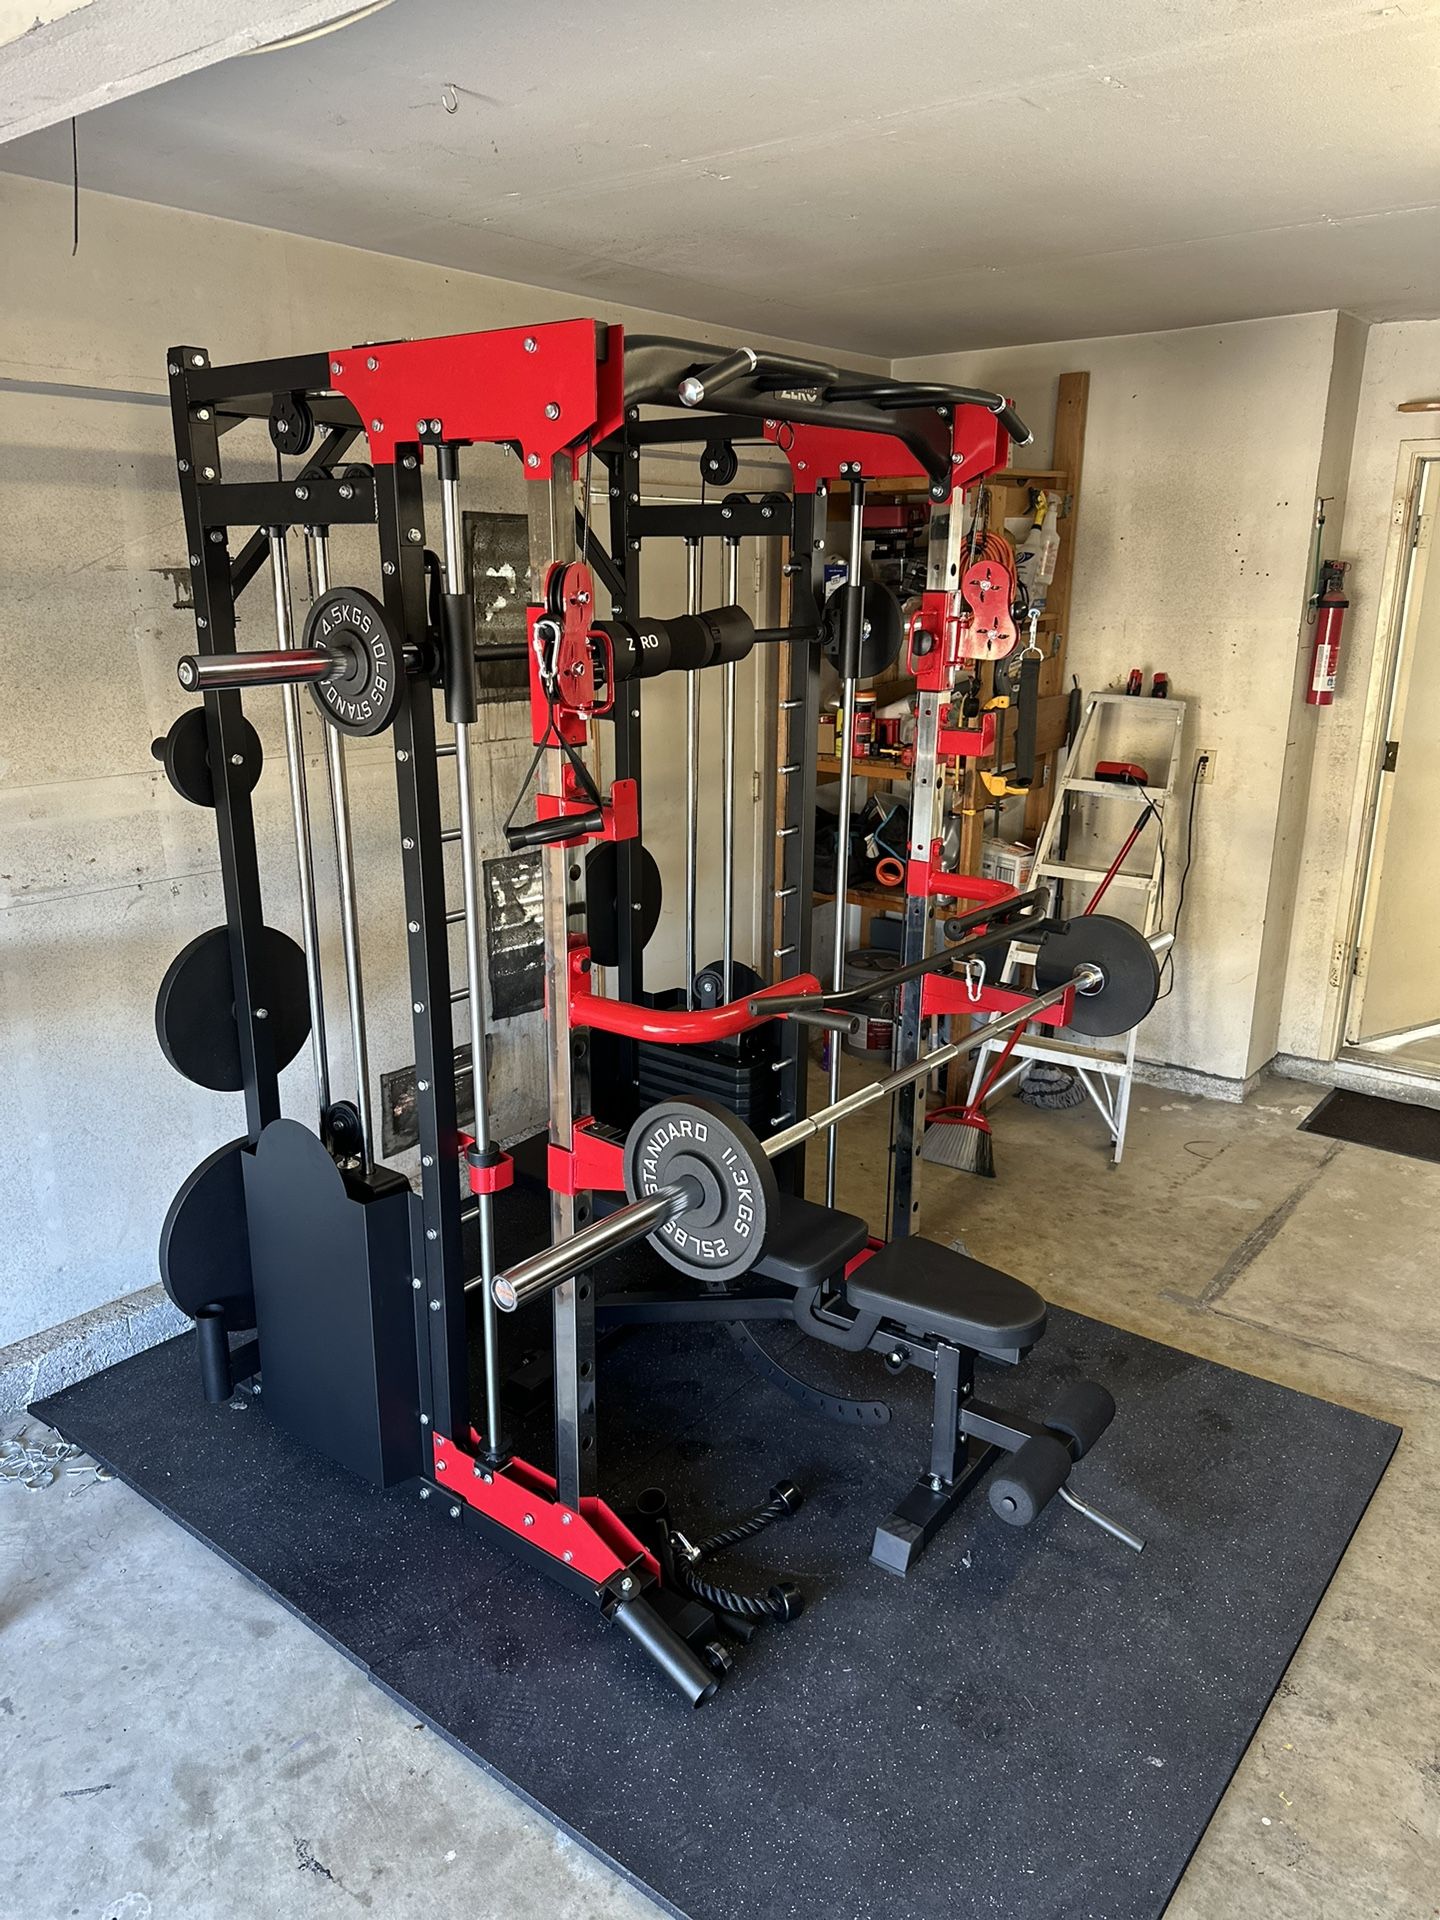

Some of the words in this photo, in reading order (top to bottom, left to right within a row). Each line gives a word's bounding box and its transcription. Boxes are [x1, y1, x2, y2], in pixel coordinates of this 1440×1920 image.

[322, 604, 372, 635] 4.5KGS
[625, 634, 659, 651] ZRO
[370, 634, 388, 706] 10LBS
[642, 1120, 708, 1197] STANDARD
[721, 1146, 754, 1238] 11.3KGS
[662, 1220, 730, 1258] 25LBS
